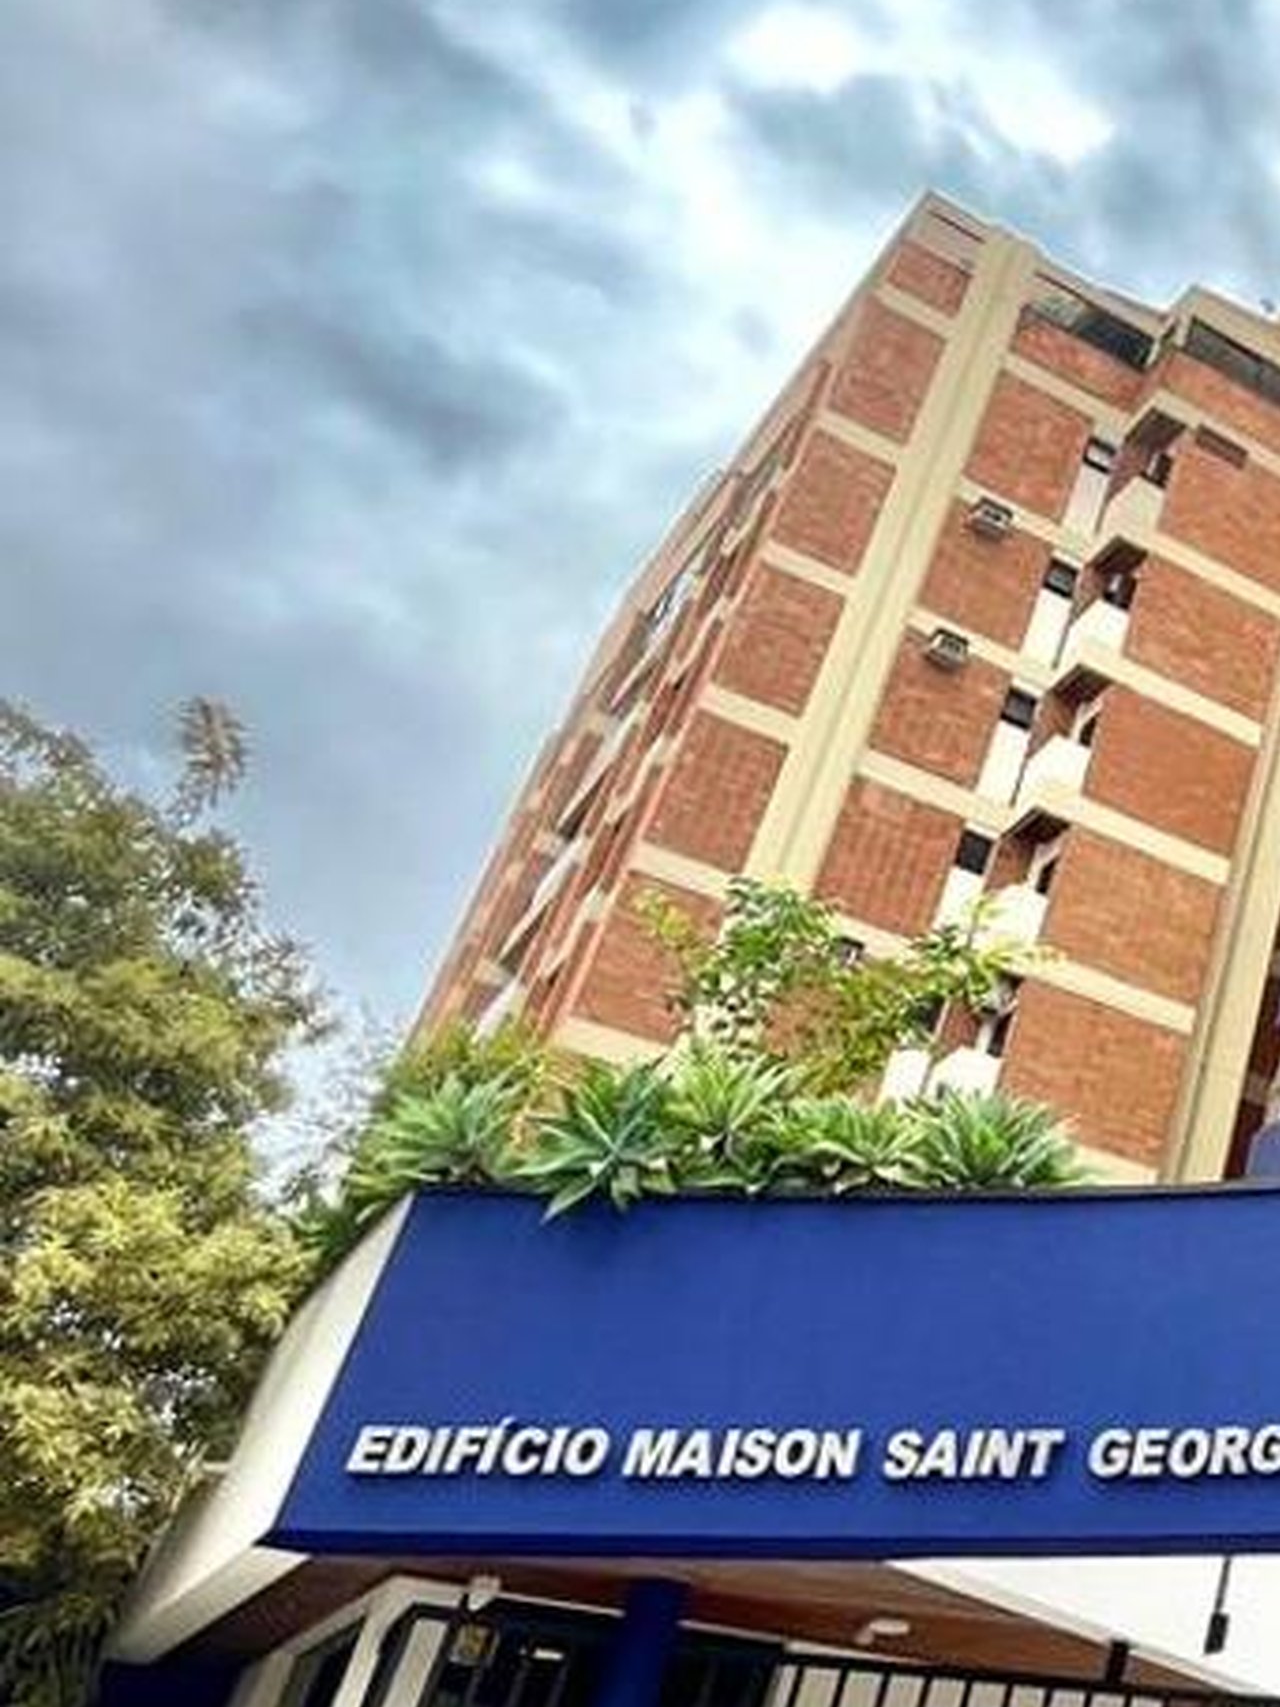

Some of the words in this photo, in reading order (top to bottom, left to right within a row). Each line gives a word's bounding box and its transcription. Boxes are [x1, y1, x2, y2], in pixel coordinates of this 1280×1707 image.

[345, 1416, 610, 1475] EDIFÍCIO
[621, 1428, 861, 1478] MAISON
[882, 1429, 1065, 1477] SAINT
